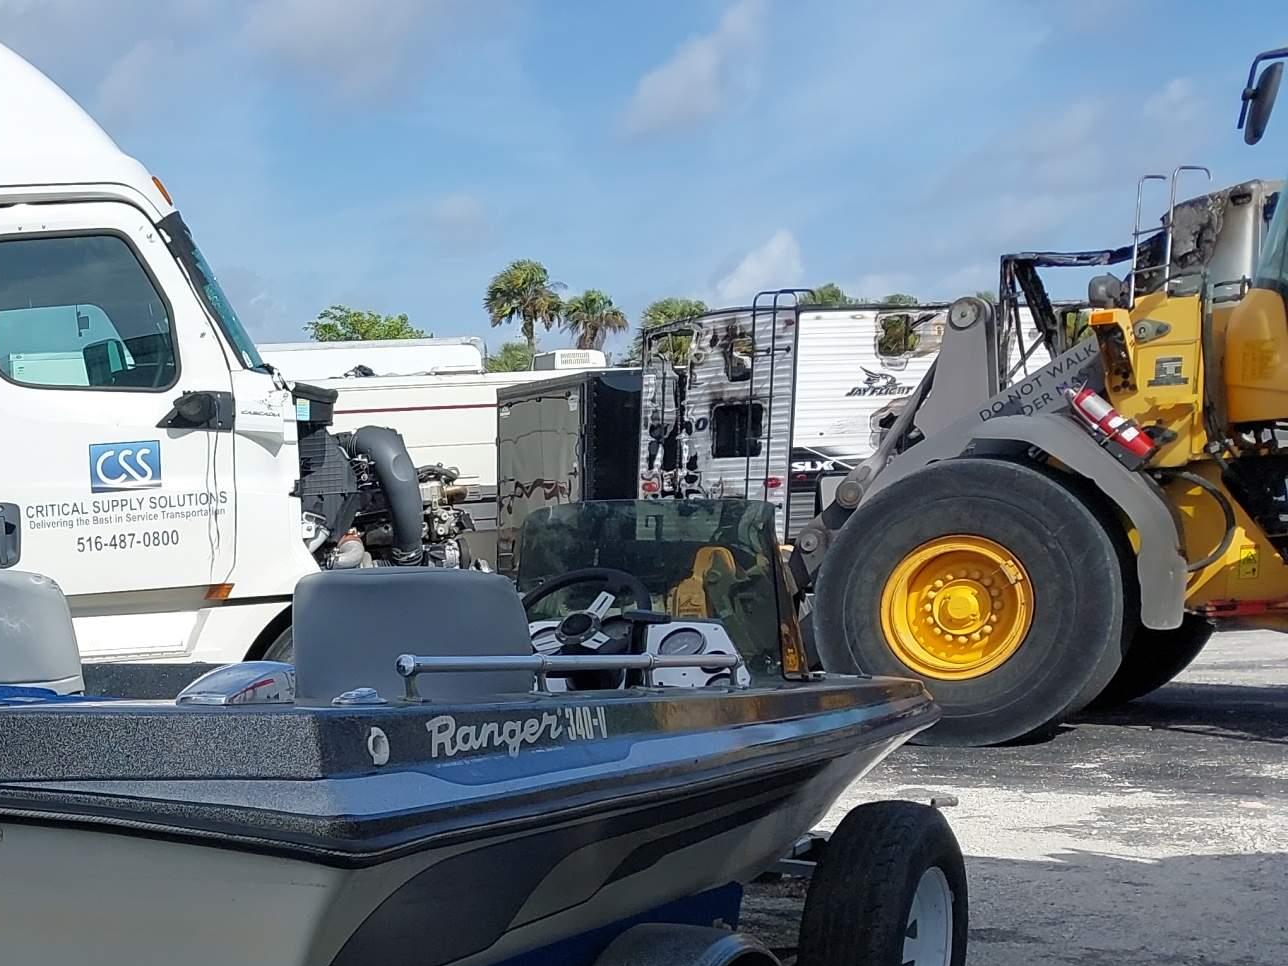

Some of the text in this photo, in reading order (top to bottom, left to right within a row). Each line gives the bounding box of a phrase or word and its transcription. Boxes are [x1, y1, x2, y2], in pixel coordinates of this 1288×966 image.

[979, 343, 1097, 421] DO NOT WALK
[96, 448, 153, 485] CSS
[791, 461, 835, 472] SLX
[25, 490, 228, 519] CRITICAL SUPPLY SOLUTIONS
[29, 518, 74, 530] Delivering
[76, 517, 90, 527] the
[92, 513, 113, 525] Best
[114, 513, 123, 524] in
[125, 510, 159, 523] Service
[77, 529, 180, 553] 516-487-0800
[425, 706, 608, 758] Ranger 340-V
